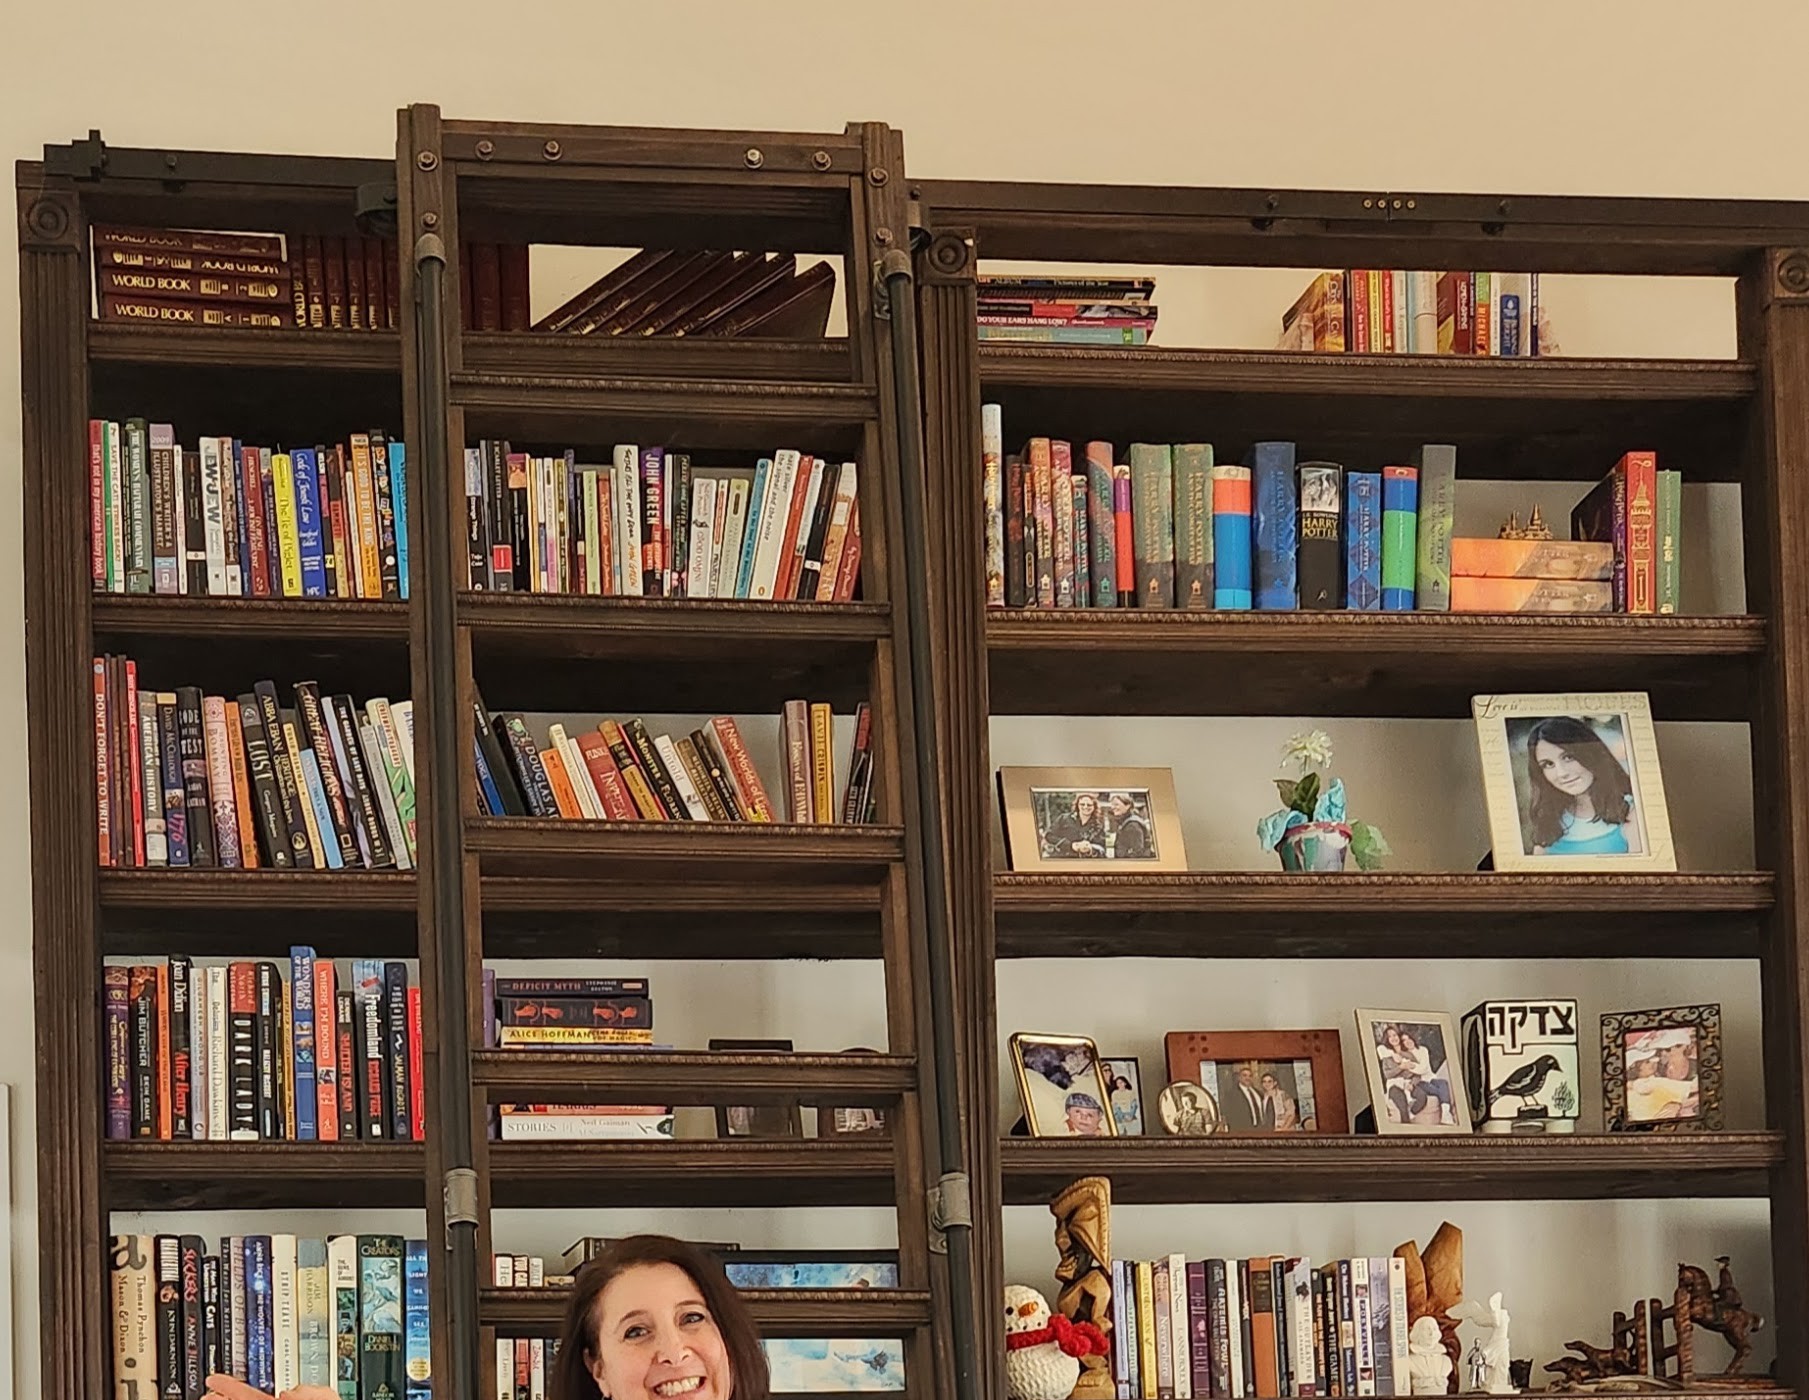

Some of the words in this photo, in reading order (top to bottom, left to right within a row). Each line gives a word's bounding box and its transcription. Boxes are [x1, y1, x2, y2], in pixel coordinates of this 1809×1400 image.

[112, 274, 155, 288] WORLD
[158, 279, 191, 290] BOOK
[116, 303, 158, 318] WORLD
[161, 309, 193, 321] BOOK
[162, 452, 171, 499] CHILDREN'S
[644, 454, 659, 484] JOHN
[646, 487, 660, 525] GREEN
[768, 507, 776, 519] the
[770, 492, 779, 505] and
[163, 502, 172, 539] WRITER'S
[284, 531, 293, 540] of
[763, 521, 774, 541] noise
[1302, 518, 1338, 528] HARRY
[1302, 528, 1338, 538] POTTER
[96, 694, 106, 726] DON'T
[262, 695, 277, 722] ABBA
[142, 715, 155, 765] AMERICAN
[208, 728, 220, 778] BOMBAY
[269, 723, 283, 750] EBAN
[96, 732, 107, 777] FORGET
[247, 739, 273, 781] LOST
[734, 750, 755, 784] Worlds
[98, 781, 108, 796] TO
[525, 745, 556, 802] DOUGLAS
[145, 769, 157, 813] HISTORY
[99, 799, 109, 834] WRITE
[169, 813, 186, 845] 1776
[173, 982, 187, 1013] Didion
[512, 982, 550, 990] DEFICIT
[554, 982, 580, 990] MYTH
[138, 1017, 147, 1067] BUTCHER
[234, 1019, 252, 1065] DARK
[364, 994, 382, 1059] Freedomland
[510, 1030, 537, 1038] ALICE
[541, 1030, 590, 1038] HOFFMAN
[1488, 1006, 1574, 1049] צדקה
[174, 1052, 188, 1080] After
[235, 1077, 253, 1122] LADY
[508, 1122, 557, 1132] STORIES
[183, 1248, 198, 1303] SUCKERS
[137, 1275, 147, 1312] Thomas
[1160, 1315, 1170, 1377] Neverwhere
